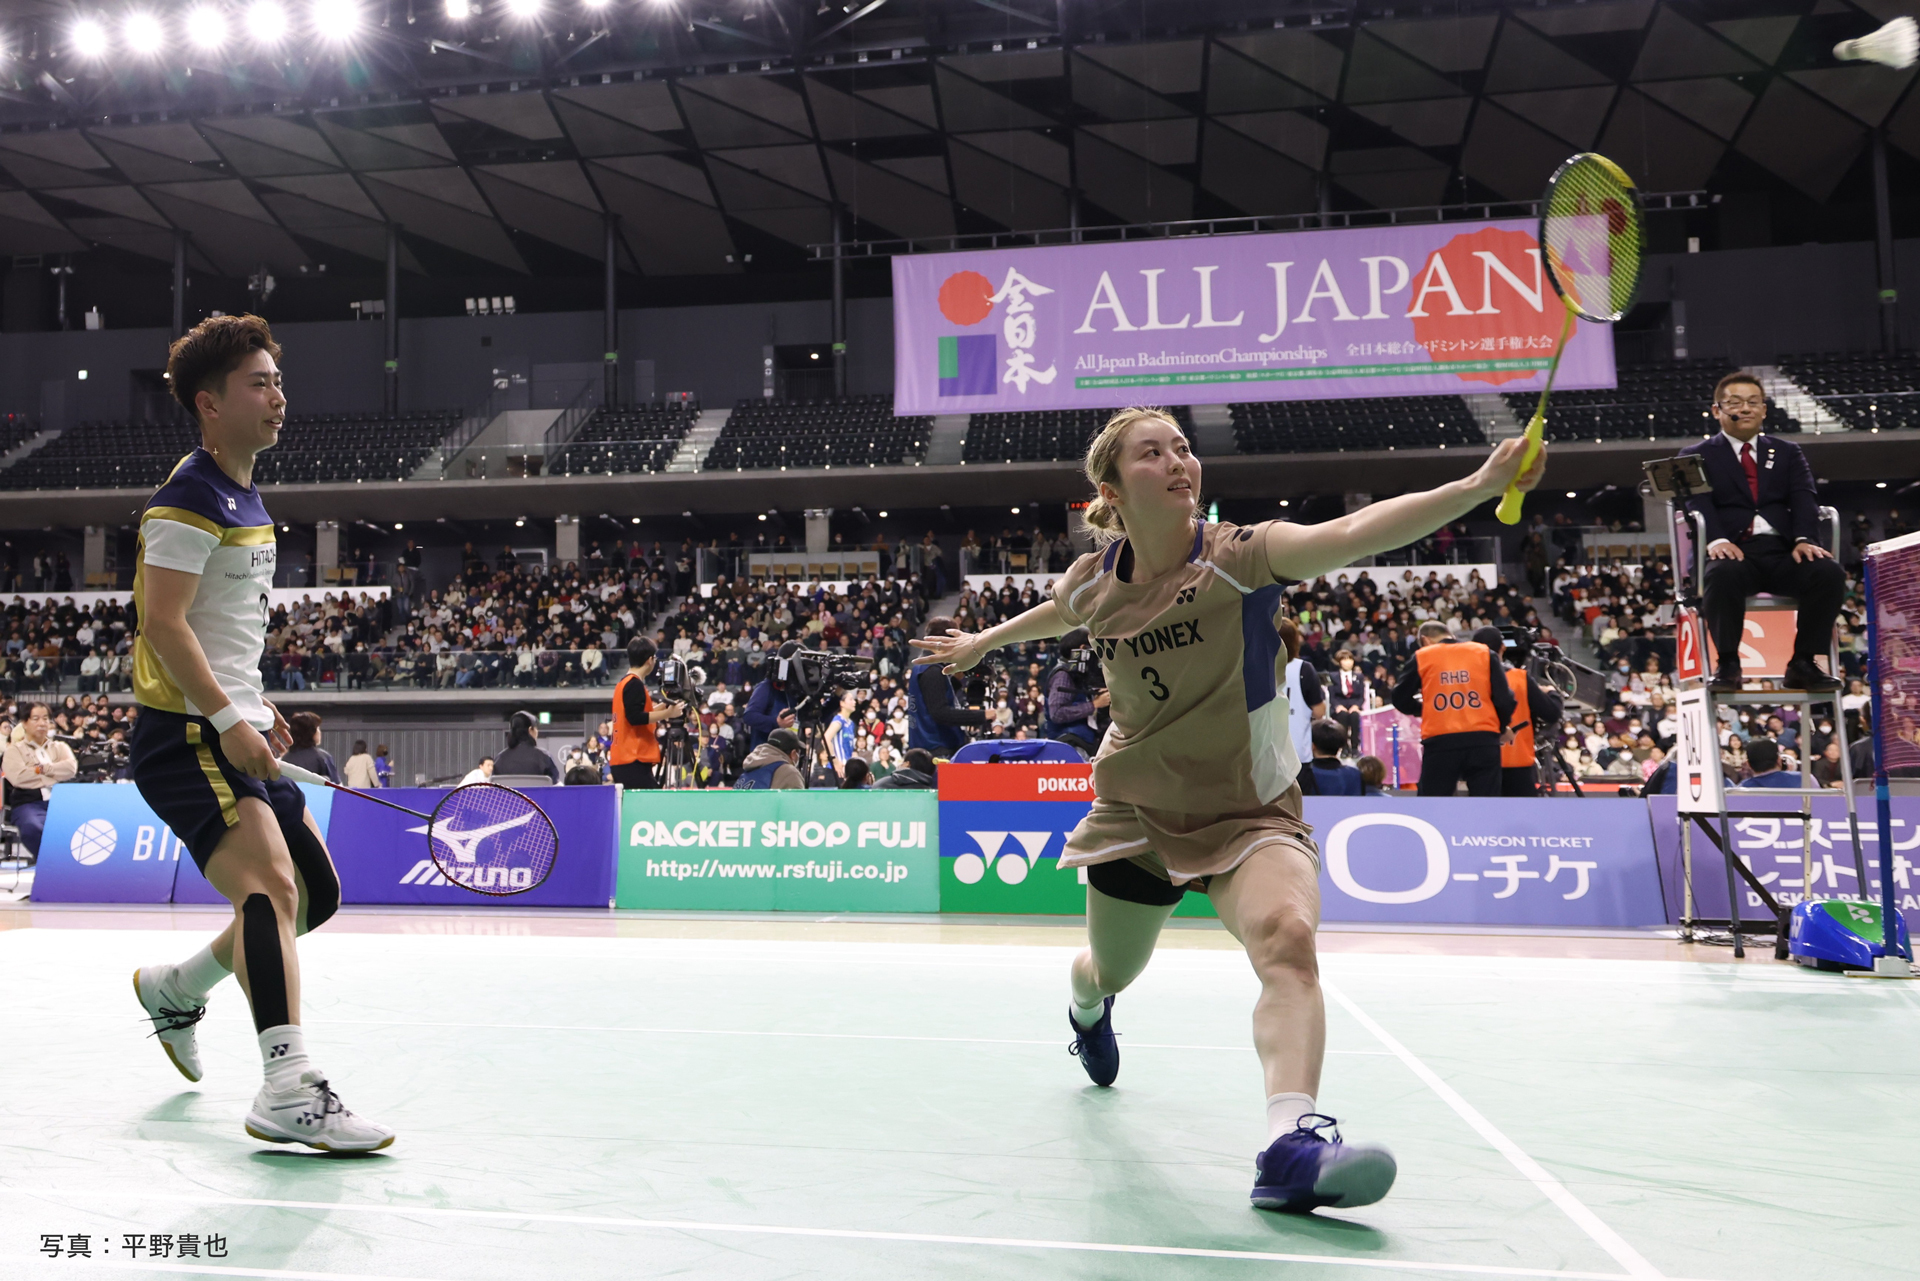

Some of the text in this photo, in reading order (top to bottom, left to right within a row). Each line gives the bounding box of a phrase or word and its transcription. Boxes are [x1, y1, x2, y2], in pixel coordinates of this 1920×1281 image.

[1073, 248, 1544, 343] ALL JAPAN
[1346, 335, 1554, 357] 全日本総合バドミントン選手権大会
[1074, 355, 1096, 370] All
[1096, 354, 1135, 373] Japan
[1123, 618, 1204, 657] YONEX
[1681, 620, 1696, 671] 2
[1141, 666, 1170, 701] 3
[1440, 670, 1470, 685] RHB
[1433, 690, 1482, 711] 008
[630, 820, 926, 848] RACKET SHOP FUJI
[1451, 835, 1594, 848] LAWSON TICKET
[646, 859, 909, 883] http://www.rsfuji.co.jp
